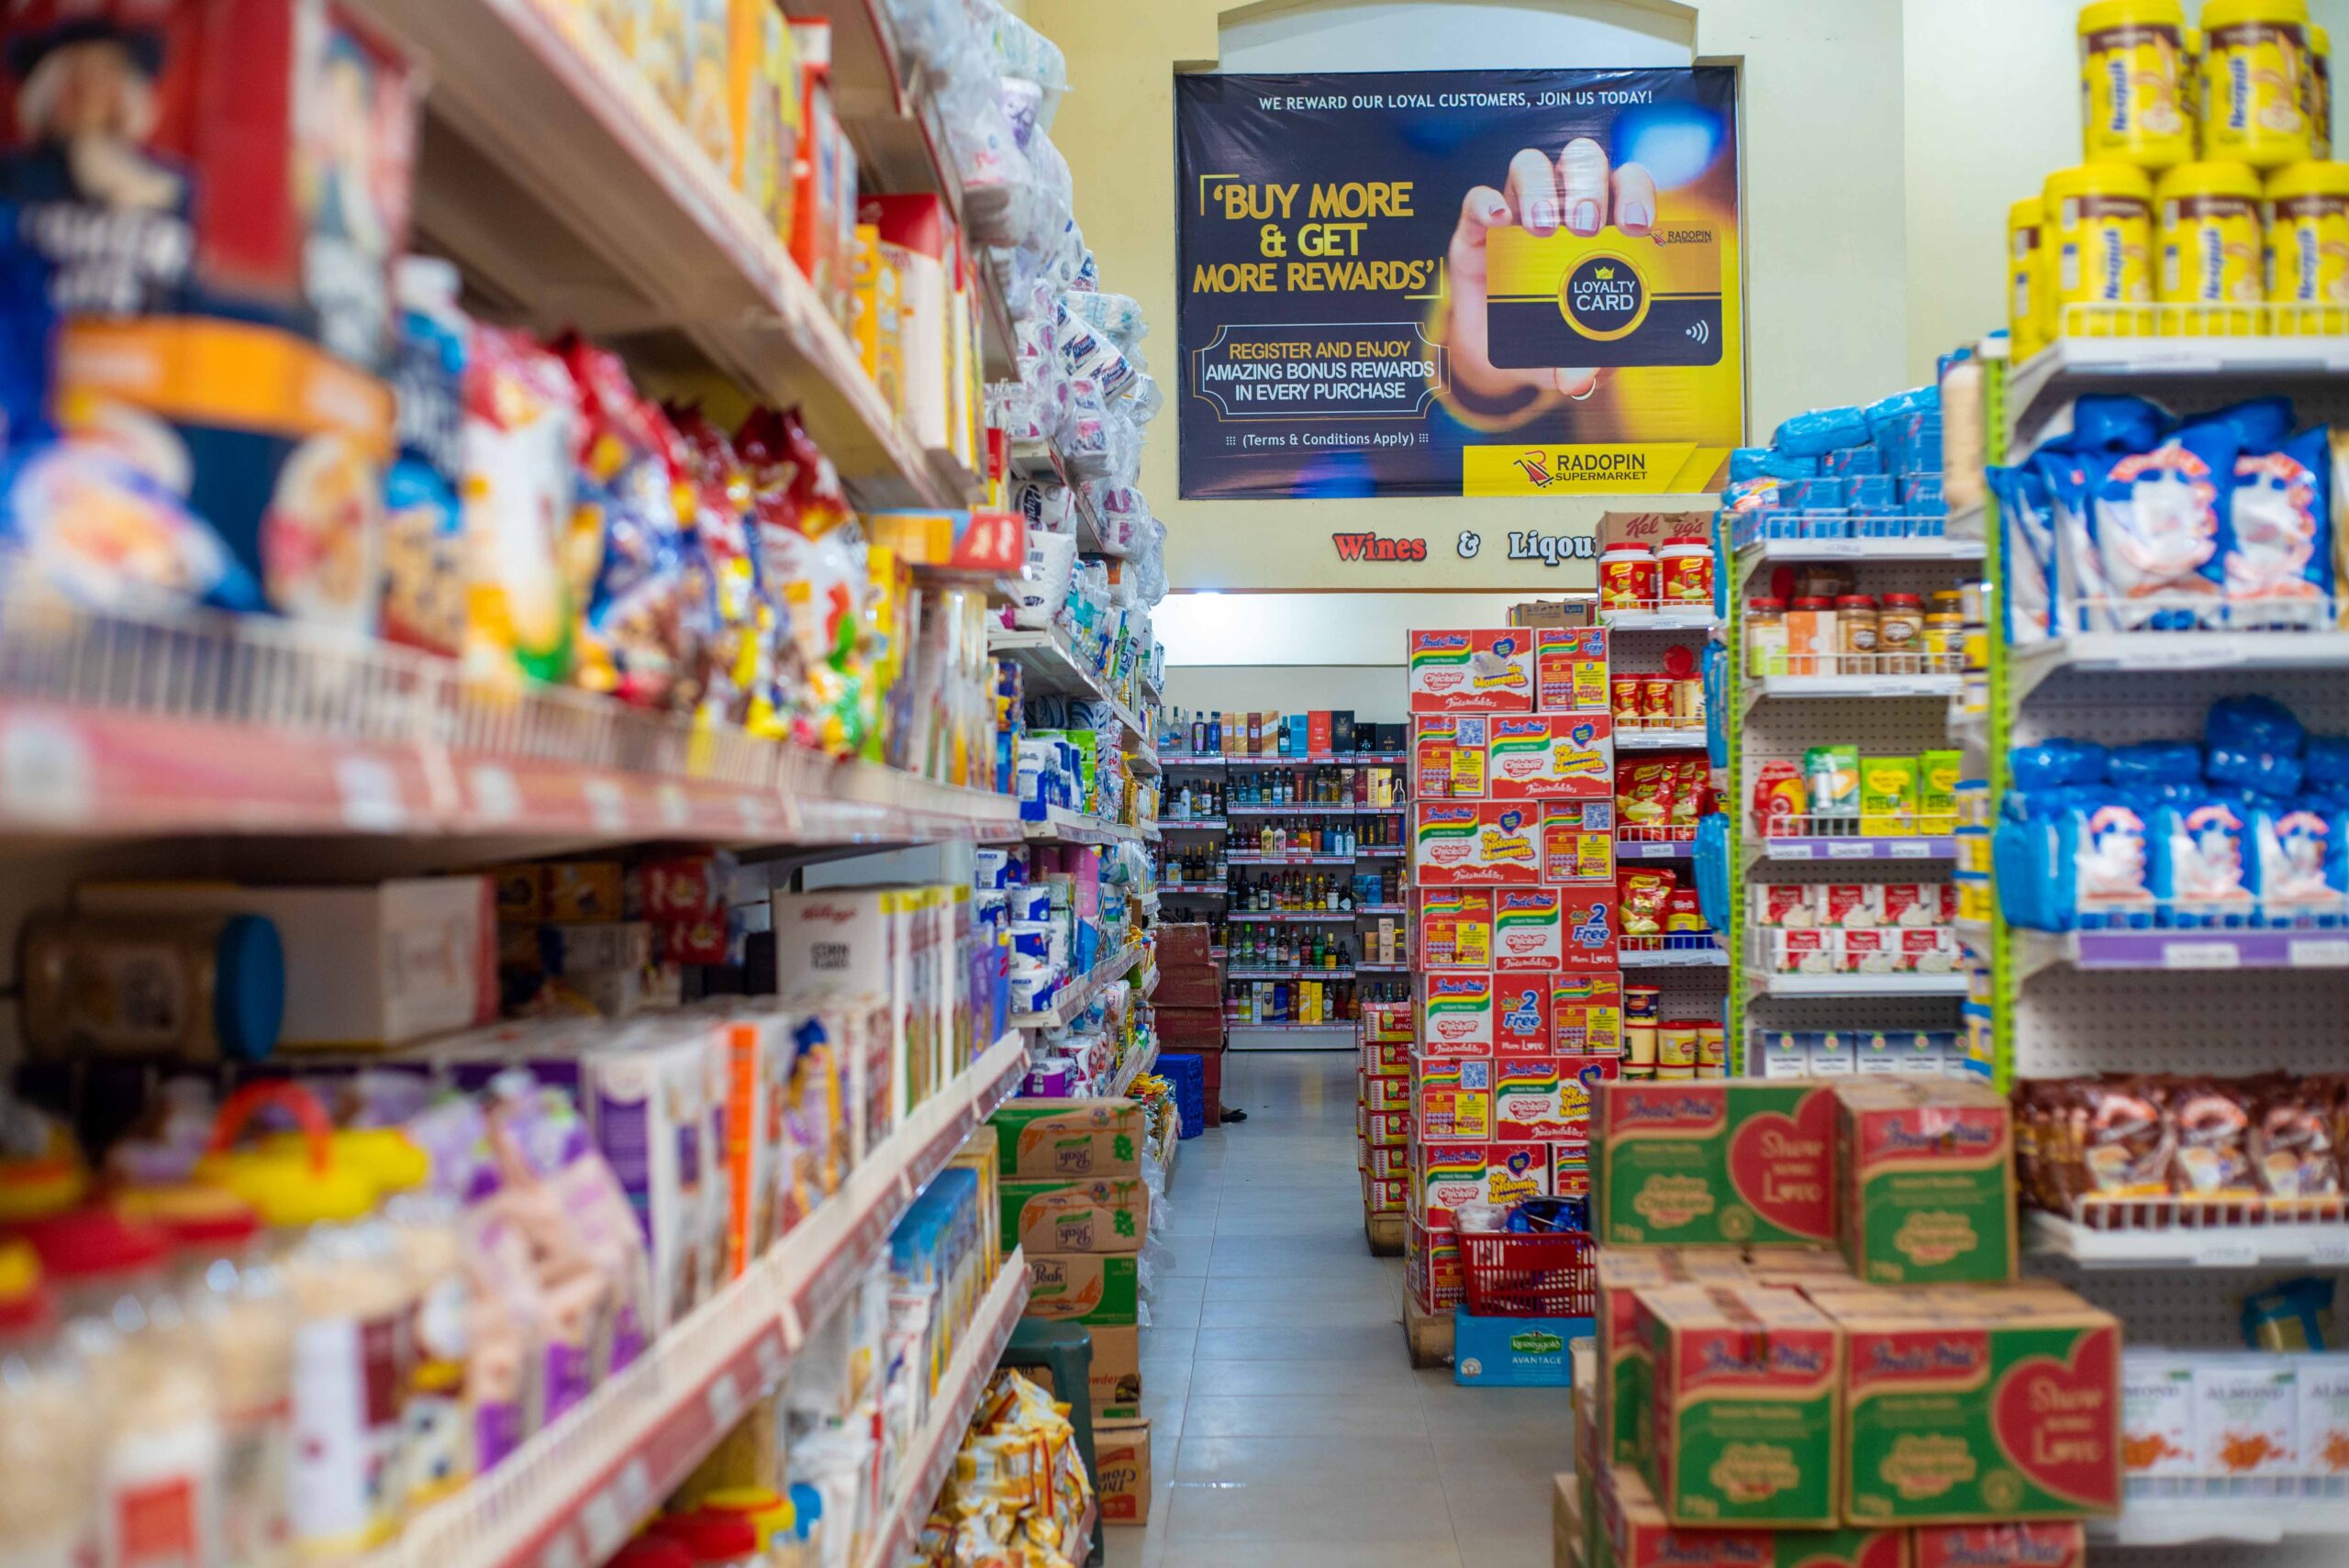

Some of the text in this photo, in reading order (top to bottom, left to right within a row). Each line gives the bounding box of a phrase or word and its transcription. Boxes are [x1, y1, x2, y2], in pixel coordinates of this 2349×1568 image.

[1259, 90, 1653, 110] WE REWARD OUR LOYAL CUSTOMERS, JOIN US TODAY!
[1308, 182, 1414, 218] MORE
[1260, 222, 1367, 258] & GET
[1668, 230, 1711, 239] RADOPIN
[1193, 262, 1278, 293] MORE
[1574, 281, 1635, 294] LOYALTY
[1576, 295, 1634, 311] CARD
[1230, 340, 1411, 360] REGISTER AND ENJOY
[1205, 361, 1435, 381] AMAZING BONUS REWARDS
[1235, 382, 1407, 401] IN EVERY PURCHASE
[1242, 431, 1415, 448] (Terms & Conditions Apply)
[1557, 453, 1645, 471] RADOPIN
[1554, 471, 1648, 481] SUPERMARKET
[1332, 530, 1597, 566] Wines & Liqou
[1592, 630, 1602, 641] 4
[1590, 903, 1608, 925] 2
[1573, 925, 1610, 941] Free
[1520, 990, 1538, 1011] 2
[1504, 1012, 1542, 1028] Free
